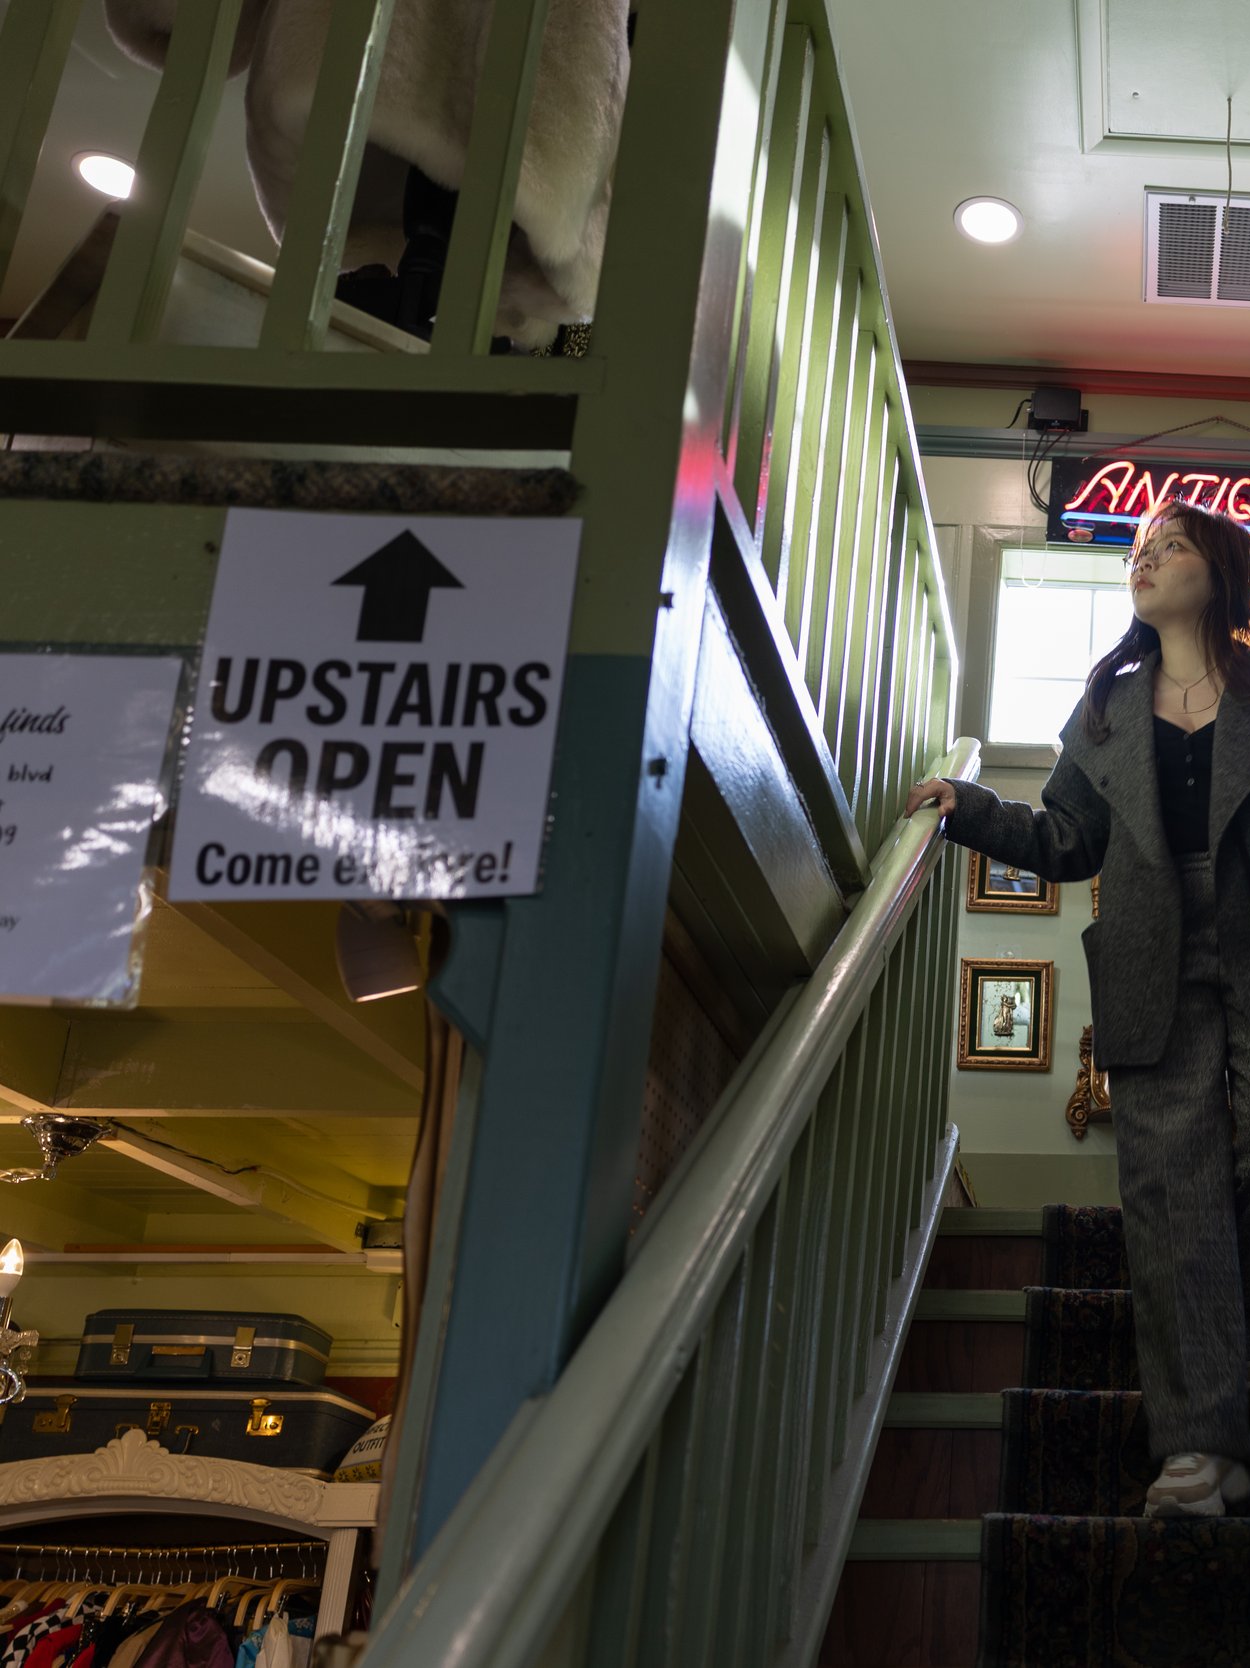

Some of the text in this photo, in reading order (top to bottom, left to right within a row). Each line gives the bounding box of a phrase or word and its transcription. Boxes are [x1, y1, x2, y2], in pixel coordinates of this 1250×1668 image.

[209, 657, 551, 728] UPSTAIRS
[8, 763, 54, 783] blvd
[254, 738, 485, 820] OPEN
[195, 841, 320, 886] Come
